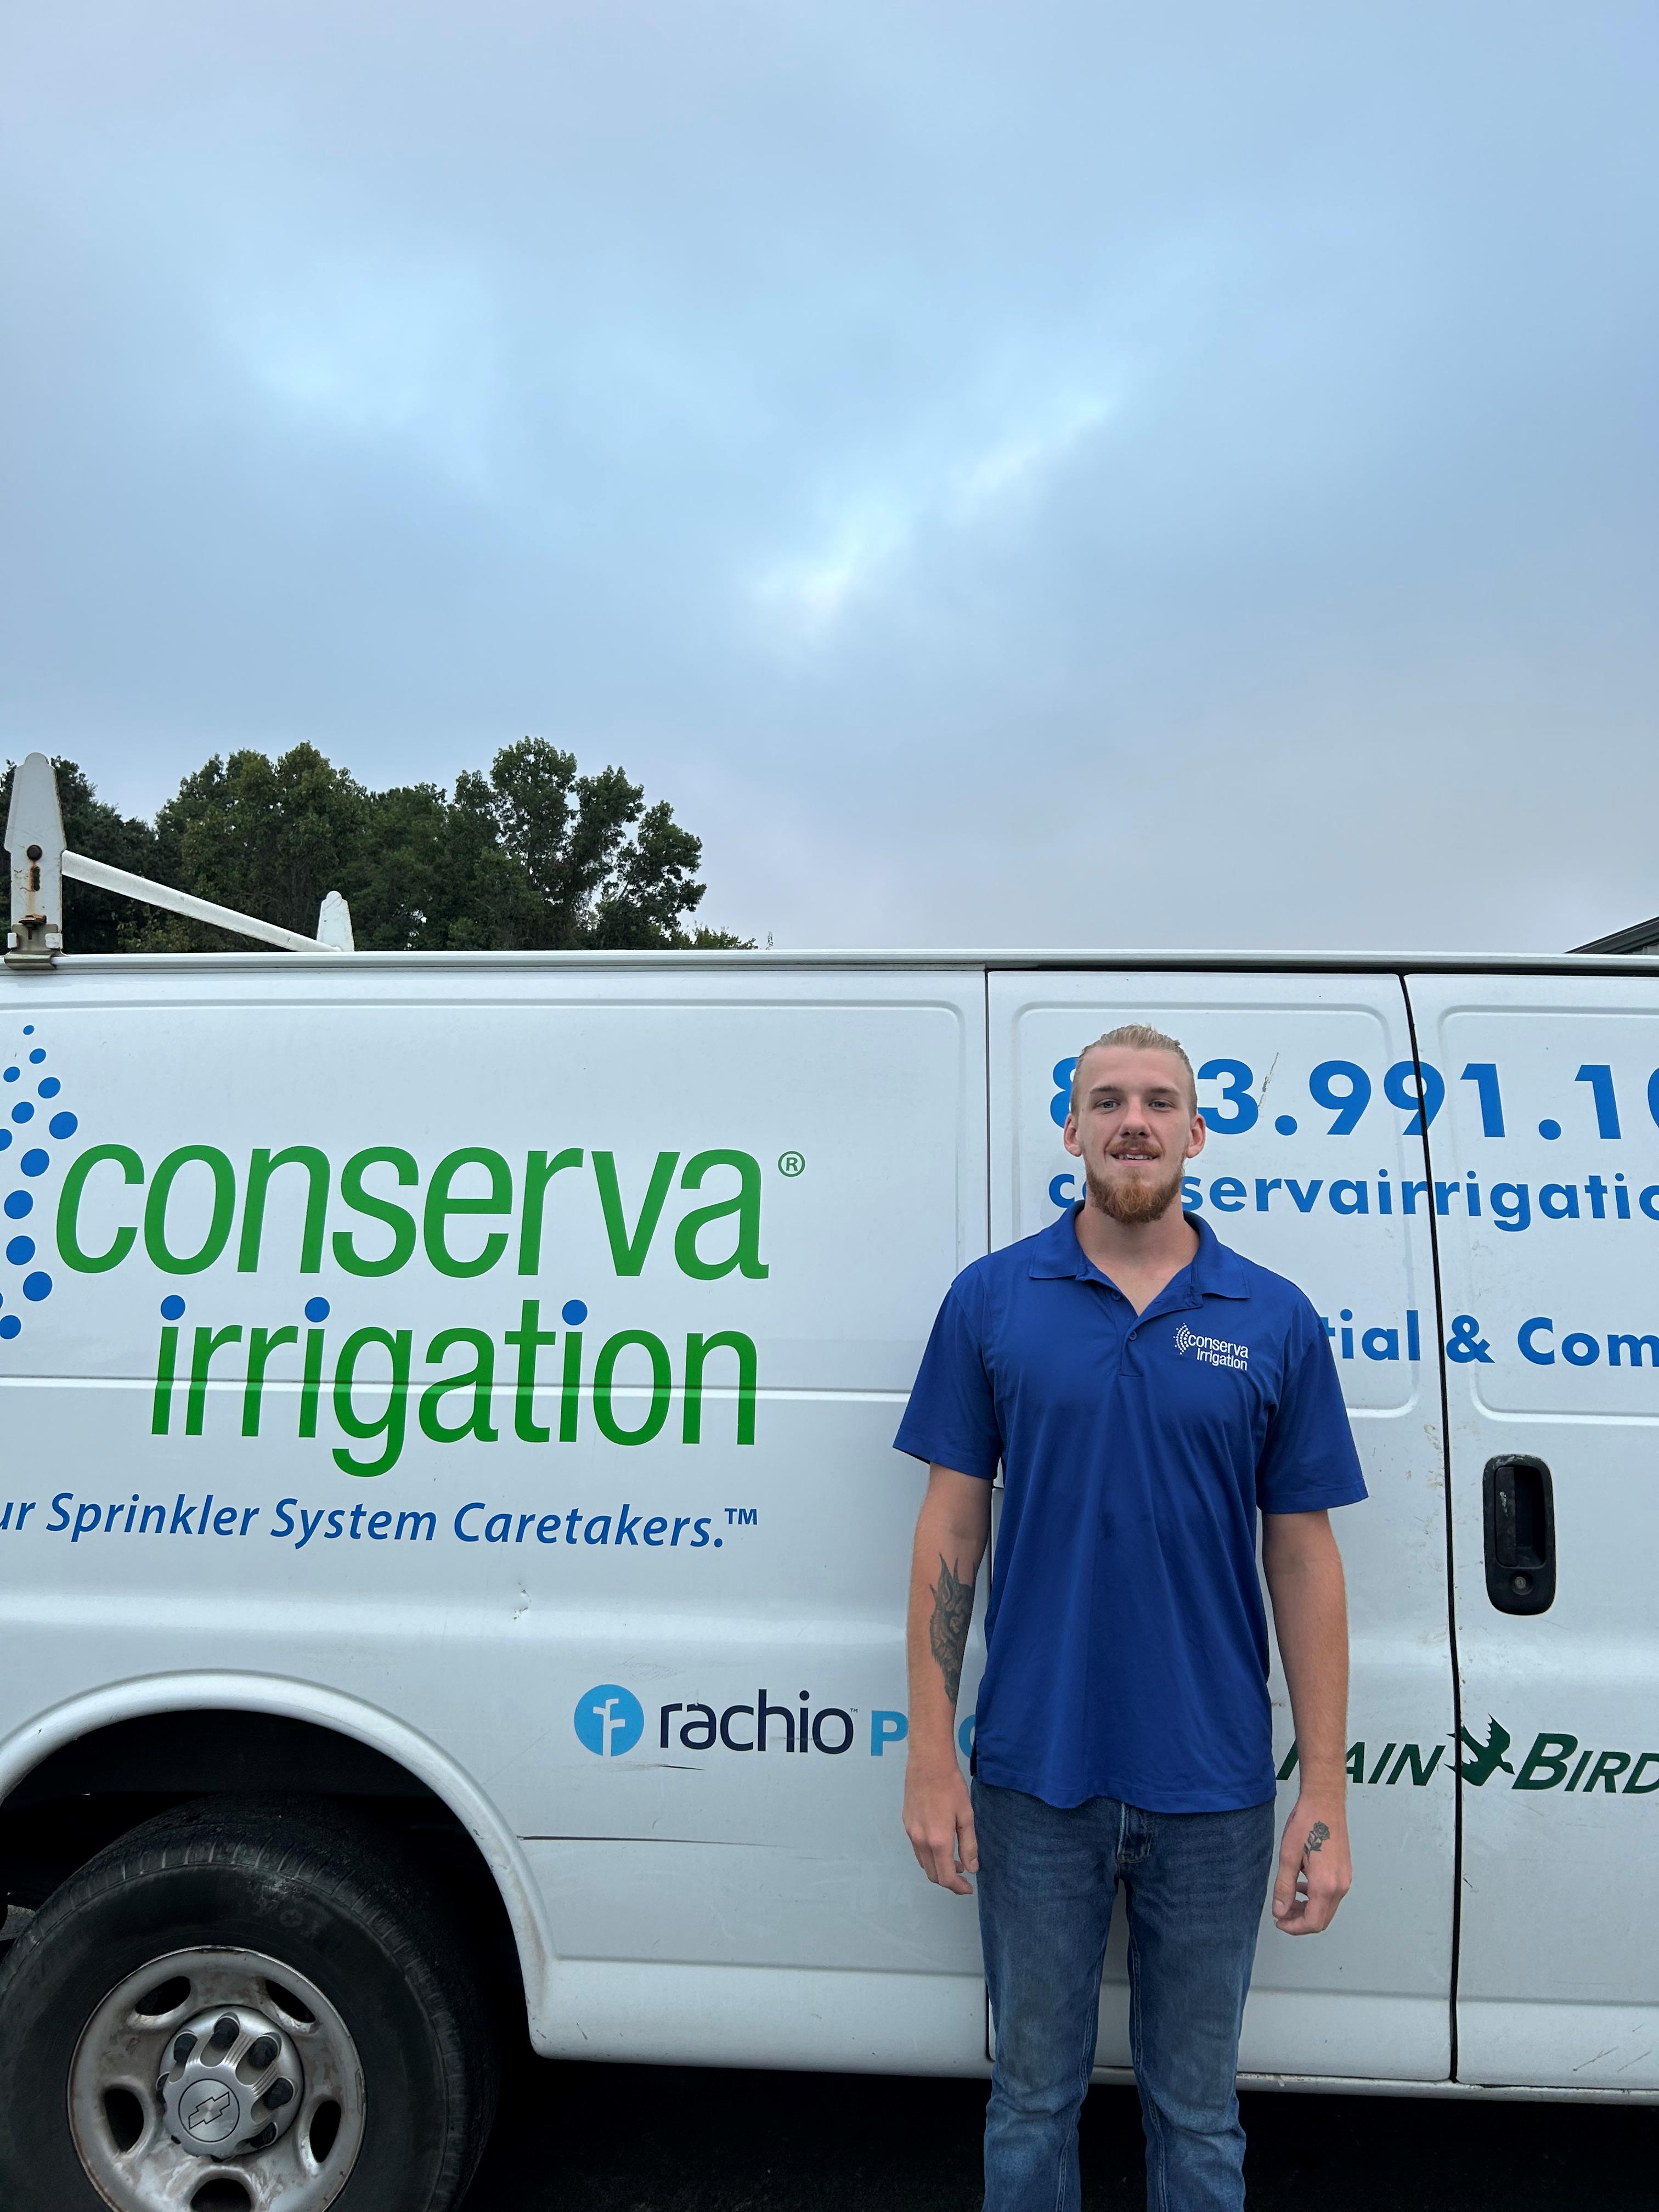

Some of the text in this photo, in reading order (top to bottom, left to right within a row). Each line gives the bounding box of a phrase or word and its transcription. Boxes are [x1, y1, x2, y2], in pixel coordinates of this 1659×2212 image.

[1050, 1057, 1659, 1139] 3.991.1
[1048, 1169, 1659, 1232] cservairrigatio
[1188, 1334, 1249, 1359] conserva
[1197, 1347, 1248, 1372] irrigation
[1320, 1308, 1420, 1361] ial
[1446, 1314, 1496, 1363] &
[151, 1295, 757, 1477] irrigation
[46, 1492, 259, 1543] Sprinkler
[270, 1498, 437, 1550] System
[1276, 1733, 1659, 1795] AIN BIRD
